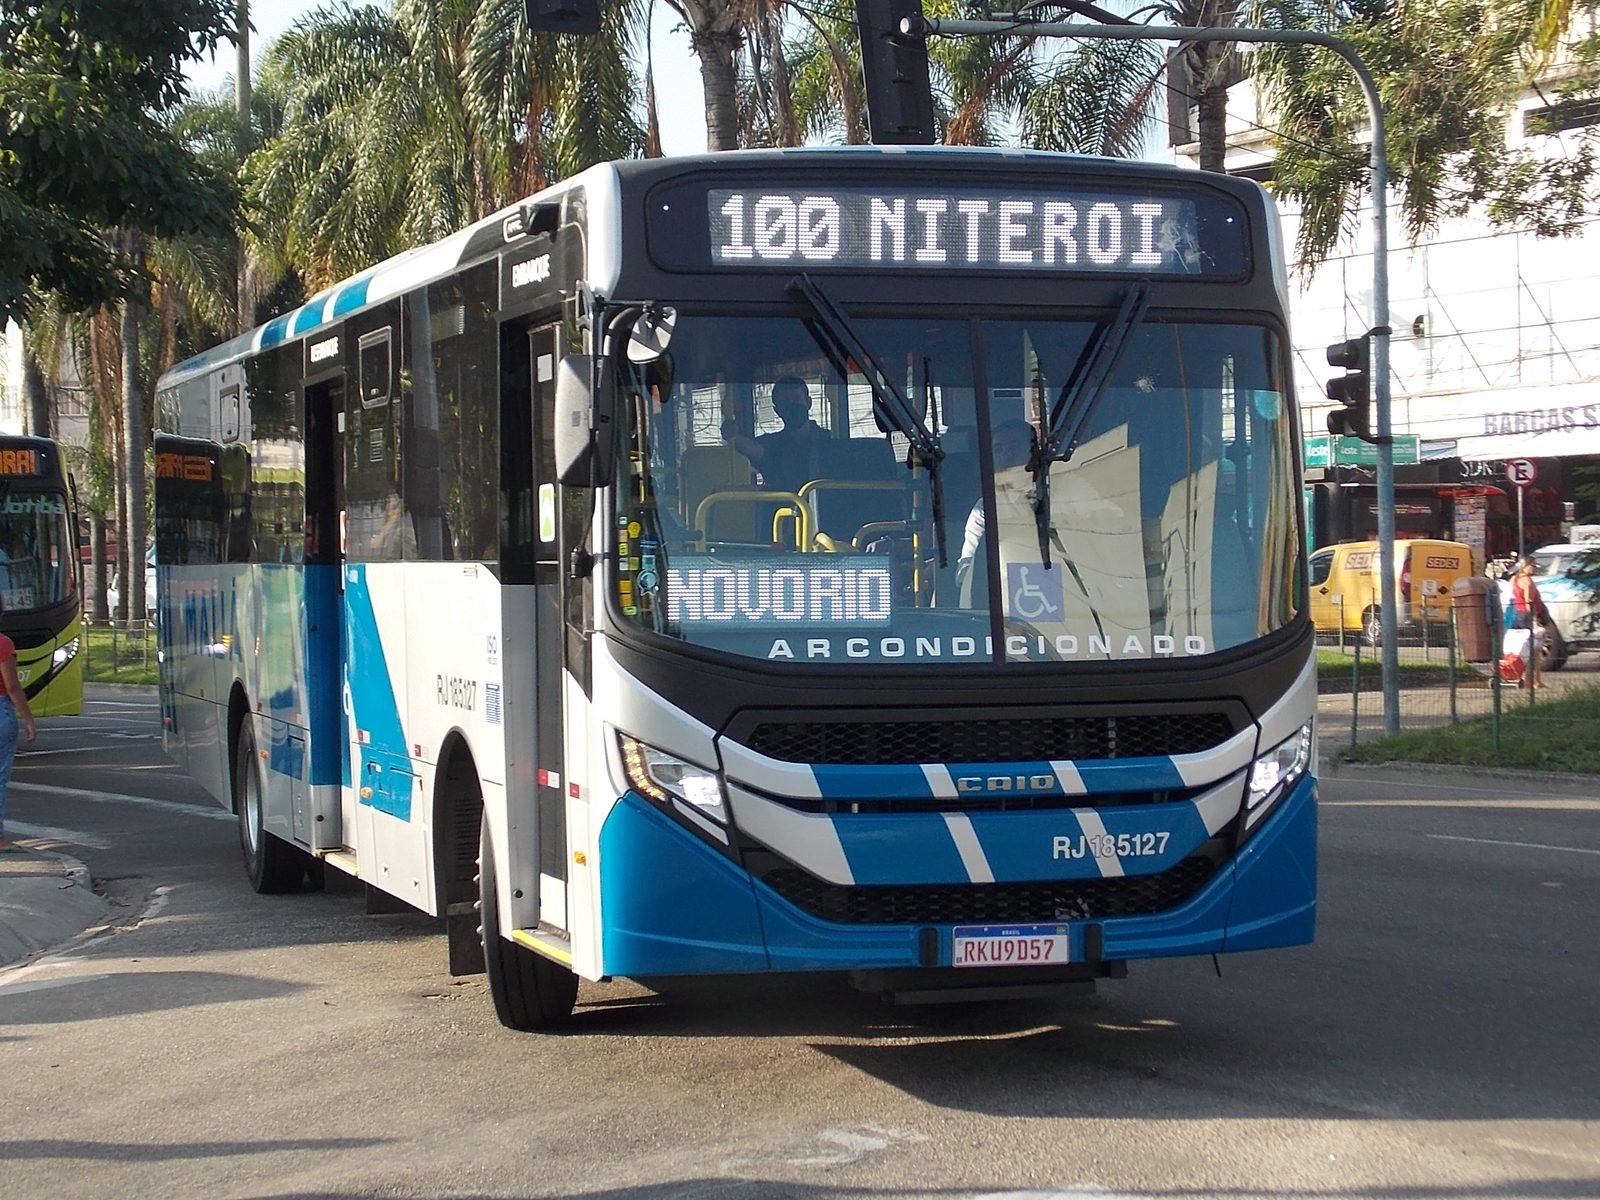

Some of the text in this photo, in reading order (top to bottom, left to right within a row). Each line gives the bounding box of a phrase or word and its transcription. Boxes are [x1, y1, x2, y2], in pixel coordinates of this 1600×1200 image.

[720, 194, 1163, 264] 100 NITEROI
[1427, 557, 1459, 568] SEDEX
[957, 775, 1054, 792] CAIO
[1053, 831, 1170, 860] RJ 185.127
[964, 939, 1055, 962] RKU9D57
